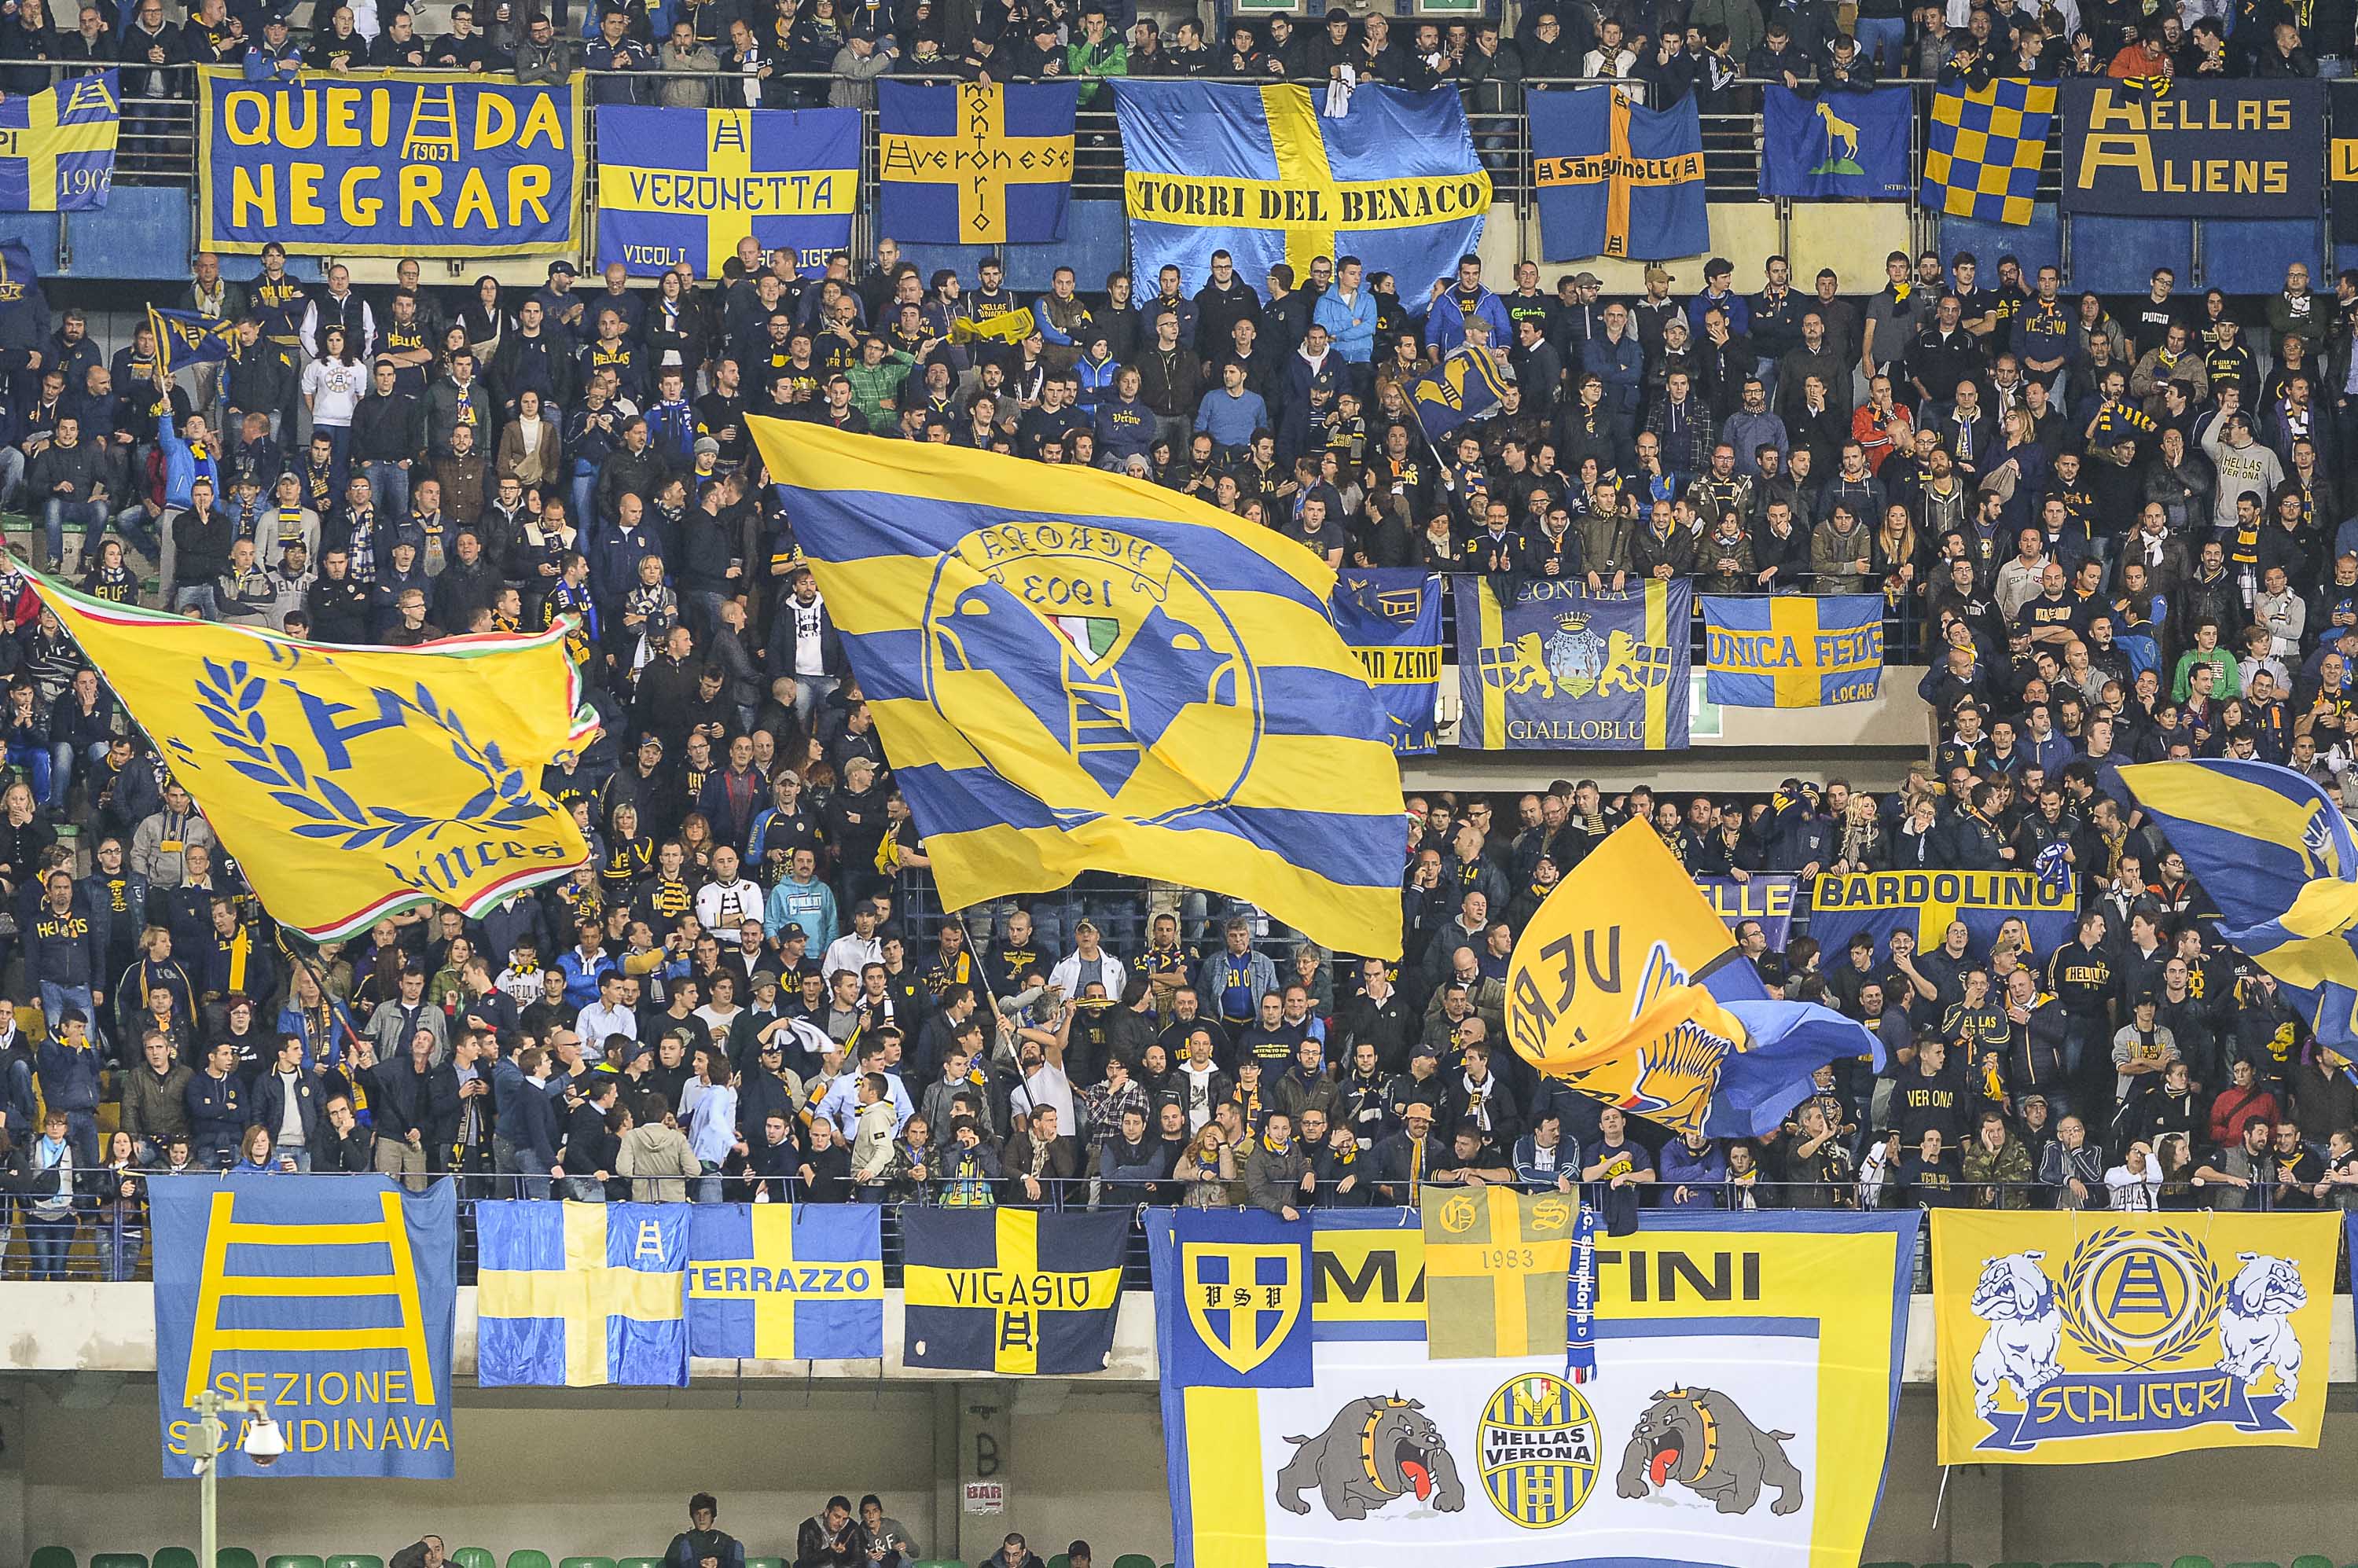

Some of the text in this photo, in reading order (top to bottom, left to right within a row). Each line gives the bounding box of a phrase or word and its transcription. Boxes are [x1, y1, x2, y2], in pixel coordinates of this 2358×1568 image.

[225, 87, 565, 151] QUEI DA
[2089, 88, 2291, 131] HELLAS
[412, 143, 448, 162] 1903
[2077, 134, 2289, 193] ALIENS
[233, 163, 553, 230] NEGRAR
[630, 171, 832, 211] VERONETTA
[1139, 181, 1480, 223] TORRI DEL BENACO
[623, 244, 686, 266] VICOLI
[2142, 311, 2169, 325] PUMA
[593, 351, 631, 367] HELLAS
[2222, 454, 2263, 473] HELLAS
[1708, 626, 1883, 668] UNICA FEDE
[1394, 651, 1438, 679] ZENO
[1832, 682, 1875, 704] LOCAR
[1508, 720, 1646, 740] GIALLOBLU
[1820, 873, 2064, 908] BARDOLINO
[1482, 1250, 1535, 1270] 1983
[689, 1267, 869, 1293] TERRAZZO
[947, 1271, 1089, 1307] VIGASIO
[215, 1370, 408, 1406] SEZIONE
[2036, 1379, 2231, 1424] SCALIGERI
[1492, 1427, 1585, 1447] HELLAS
[1486, 1445, 1592, 1464] VERONA
[967, 1486, 1002, 1500] BAR
